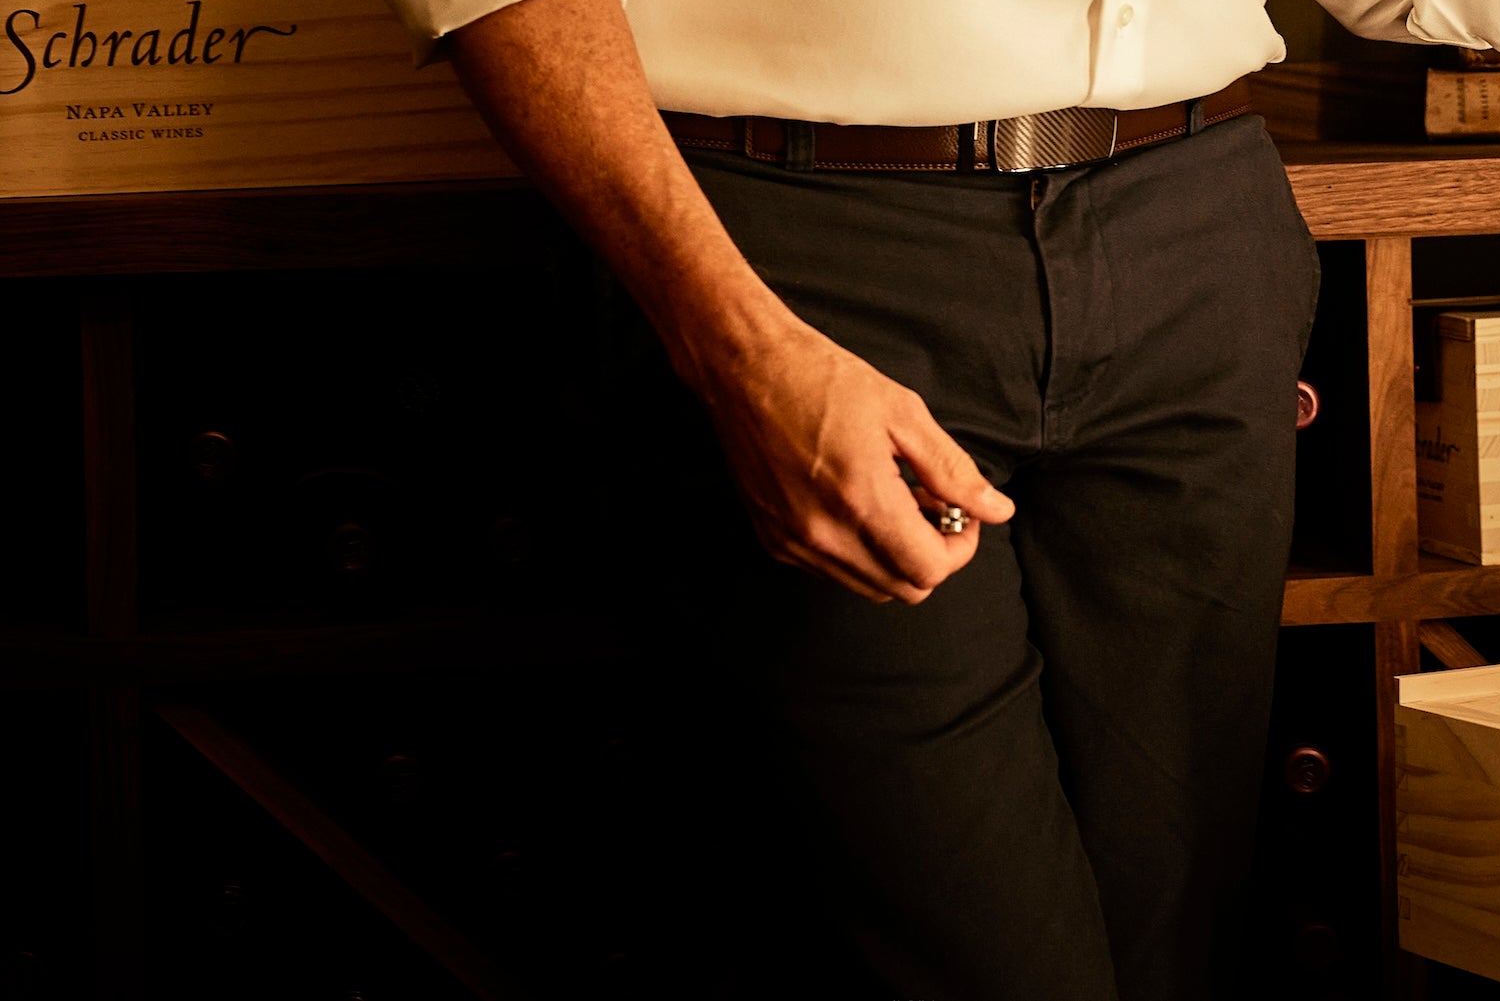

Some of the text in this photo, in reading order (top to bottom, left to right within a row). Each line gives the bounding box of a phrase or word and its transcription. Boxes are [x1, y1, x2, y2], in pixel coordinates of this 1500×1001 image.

[0, 1, 297, 94] Schrader
[66, 103, 214, 120] NAPA VALLEY
[78, 127, 204, 142] CLASSIC WINES
